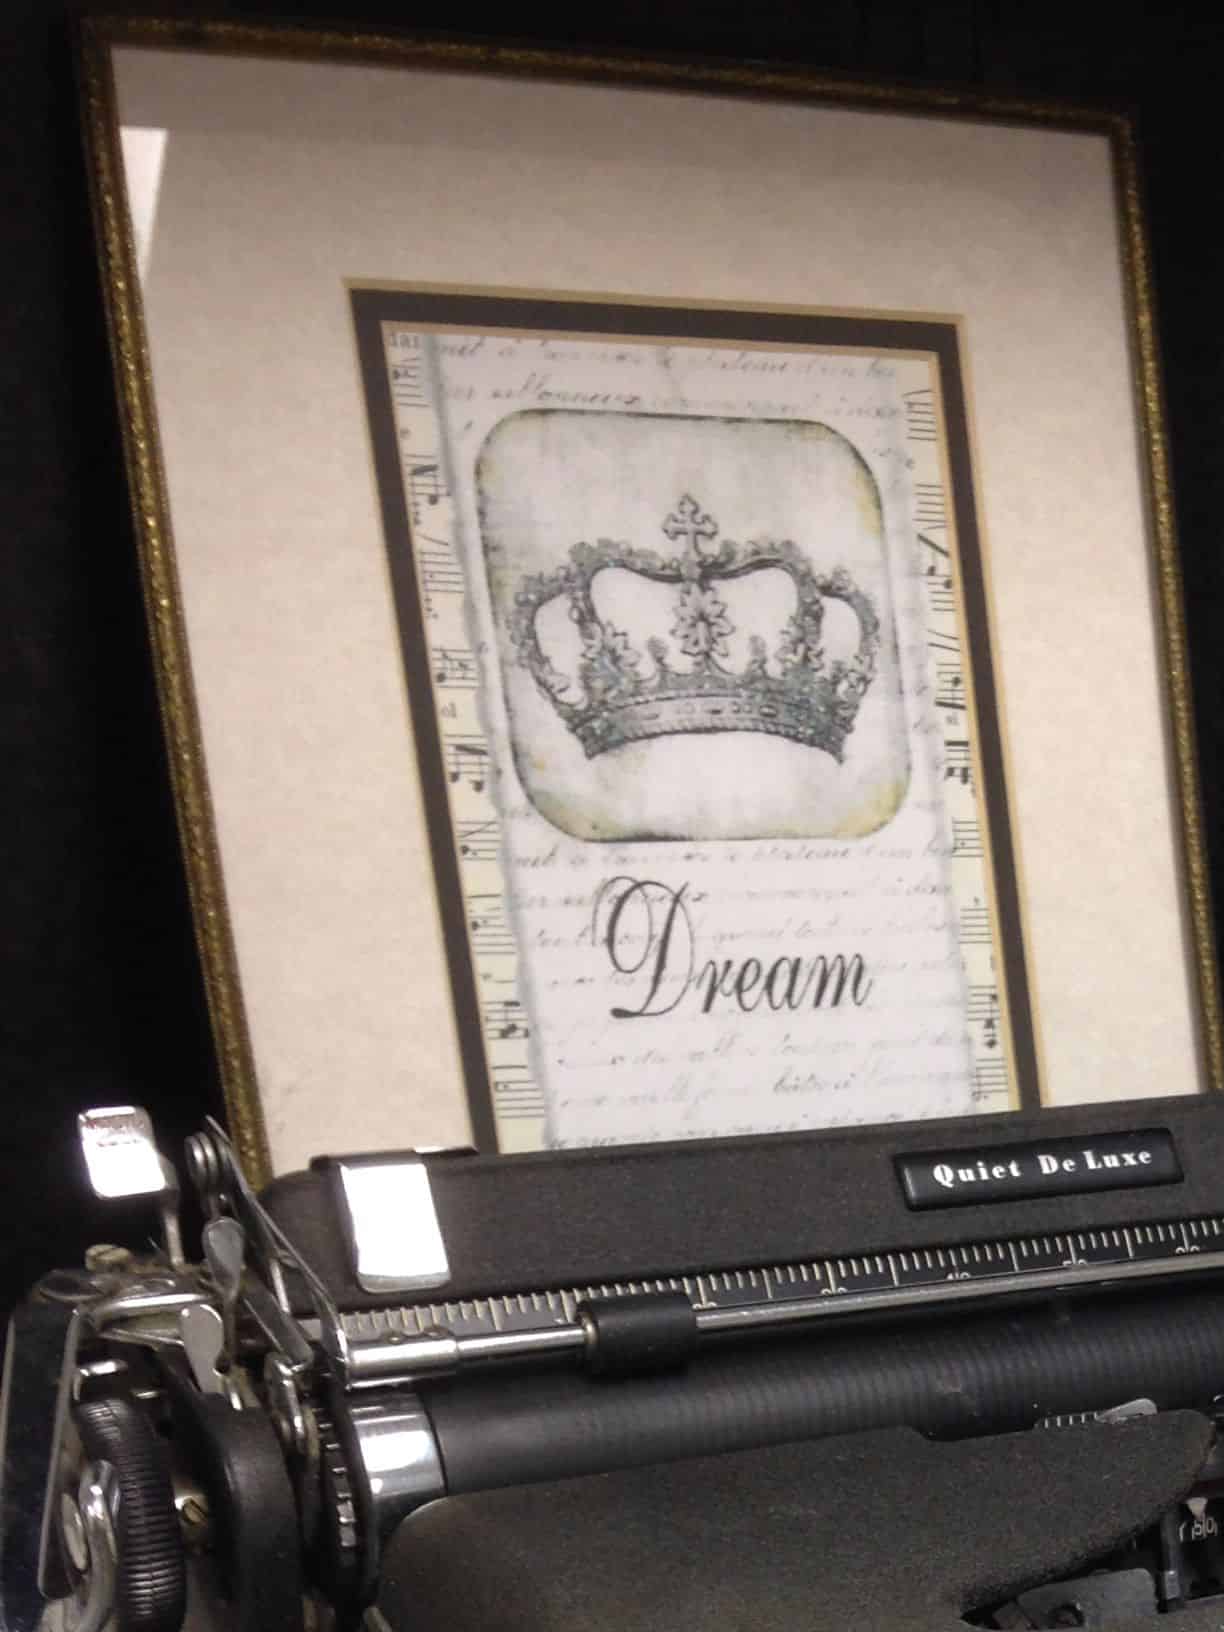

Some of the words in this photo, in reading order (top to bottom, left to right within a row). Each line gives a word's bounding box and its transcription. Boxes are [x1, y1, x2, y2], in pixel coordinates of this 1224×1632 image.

[591, 876, 872, 1018] Dream
[933, 1161, 1021, 1188] Quiet
[1037, 1155, 1076, 1175] De
[1083, 1150, 1151, 1170] Luxe
